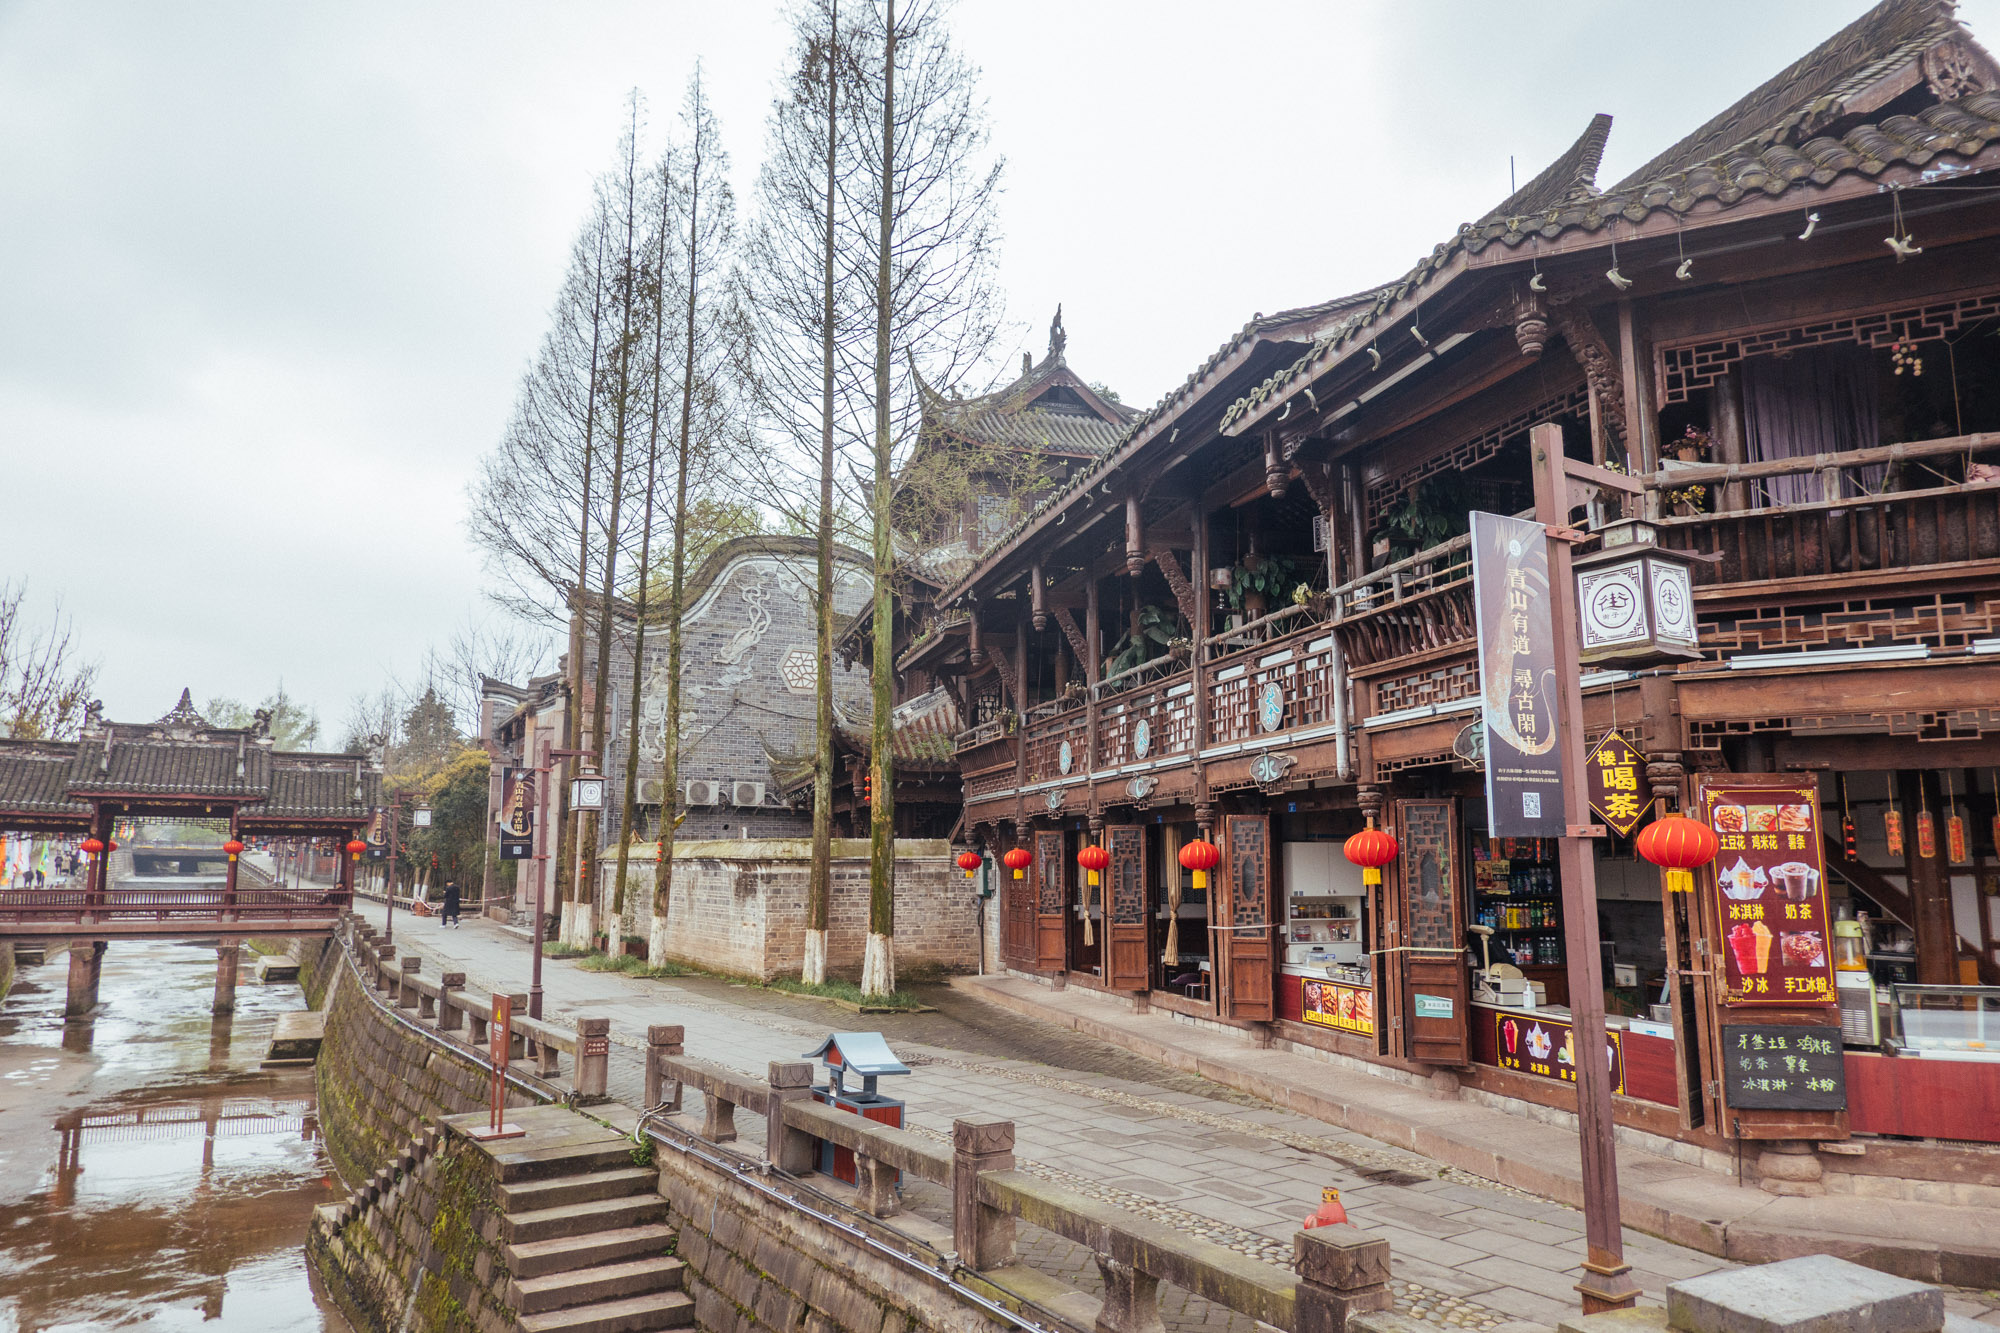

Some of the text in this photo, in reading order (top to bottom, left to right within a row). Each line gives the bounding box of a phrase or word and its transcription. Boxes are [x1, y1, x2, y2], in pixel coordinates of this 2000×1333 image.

[1508, 568, 1531, 655] 青山有道
[1263, 686, 1281, 725] 茶
[1597, 750, 1637, 766] 楼上
[1258, 756, 1278, 781] 水
[1602, 767, 1639, 818] 喝茶
[1720, 834, 1806, 850] 土豆花 鸡米花 薯条
[1729, 904, 1812, 920] 冰淇淋 奶茶
[1742, 977, 1827, 993] 沙冰 手工冰粉
[1742, 1077, 1836, 1092] 冰淇淋 冰粉
